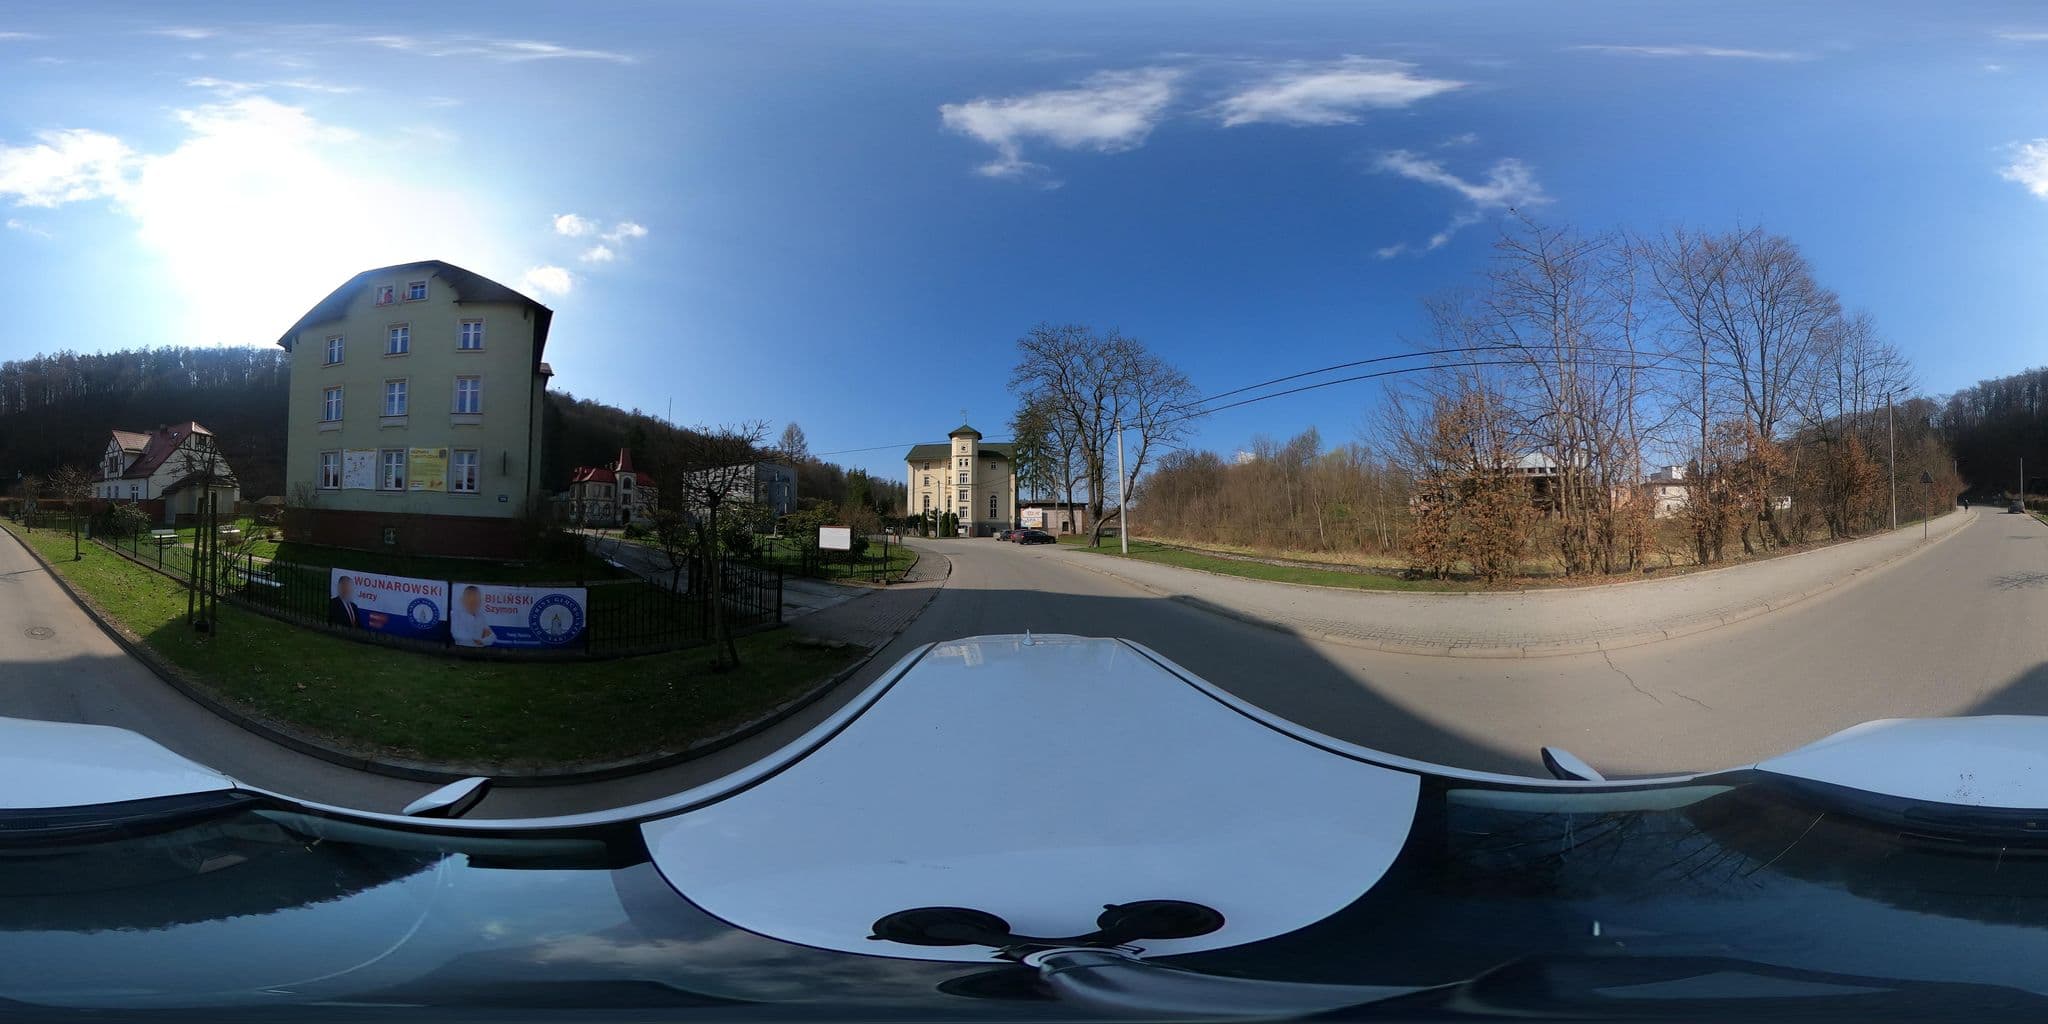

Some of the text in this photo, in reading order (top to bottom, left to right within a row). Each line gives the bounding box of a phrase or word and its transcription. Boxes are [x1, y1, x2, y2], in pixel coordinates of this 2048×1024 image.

[354, 575, 442, 596] WOJNAROWSKI
[359, 590, 378, 602] Jerzy
[484, 592, 534, 605] BILIŃSKI
[484, 604, 518, 615] Szymon
